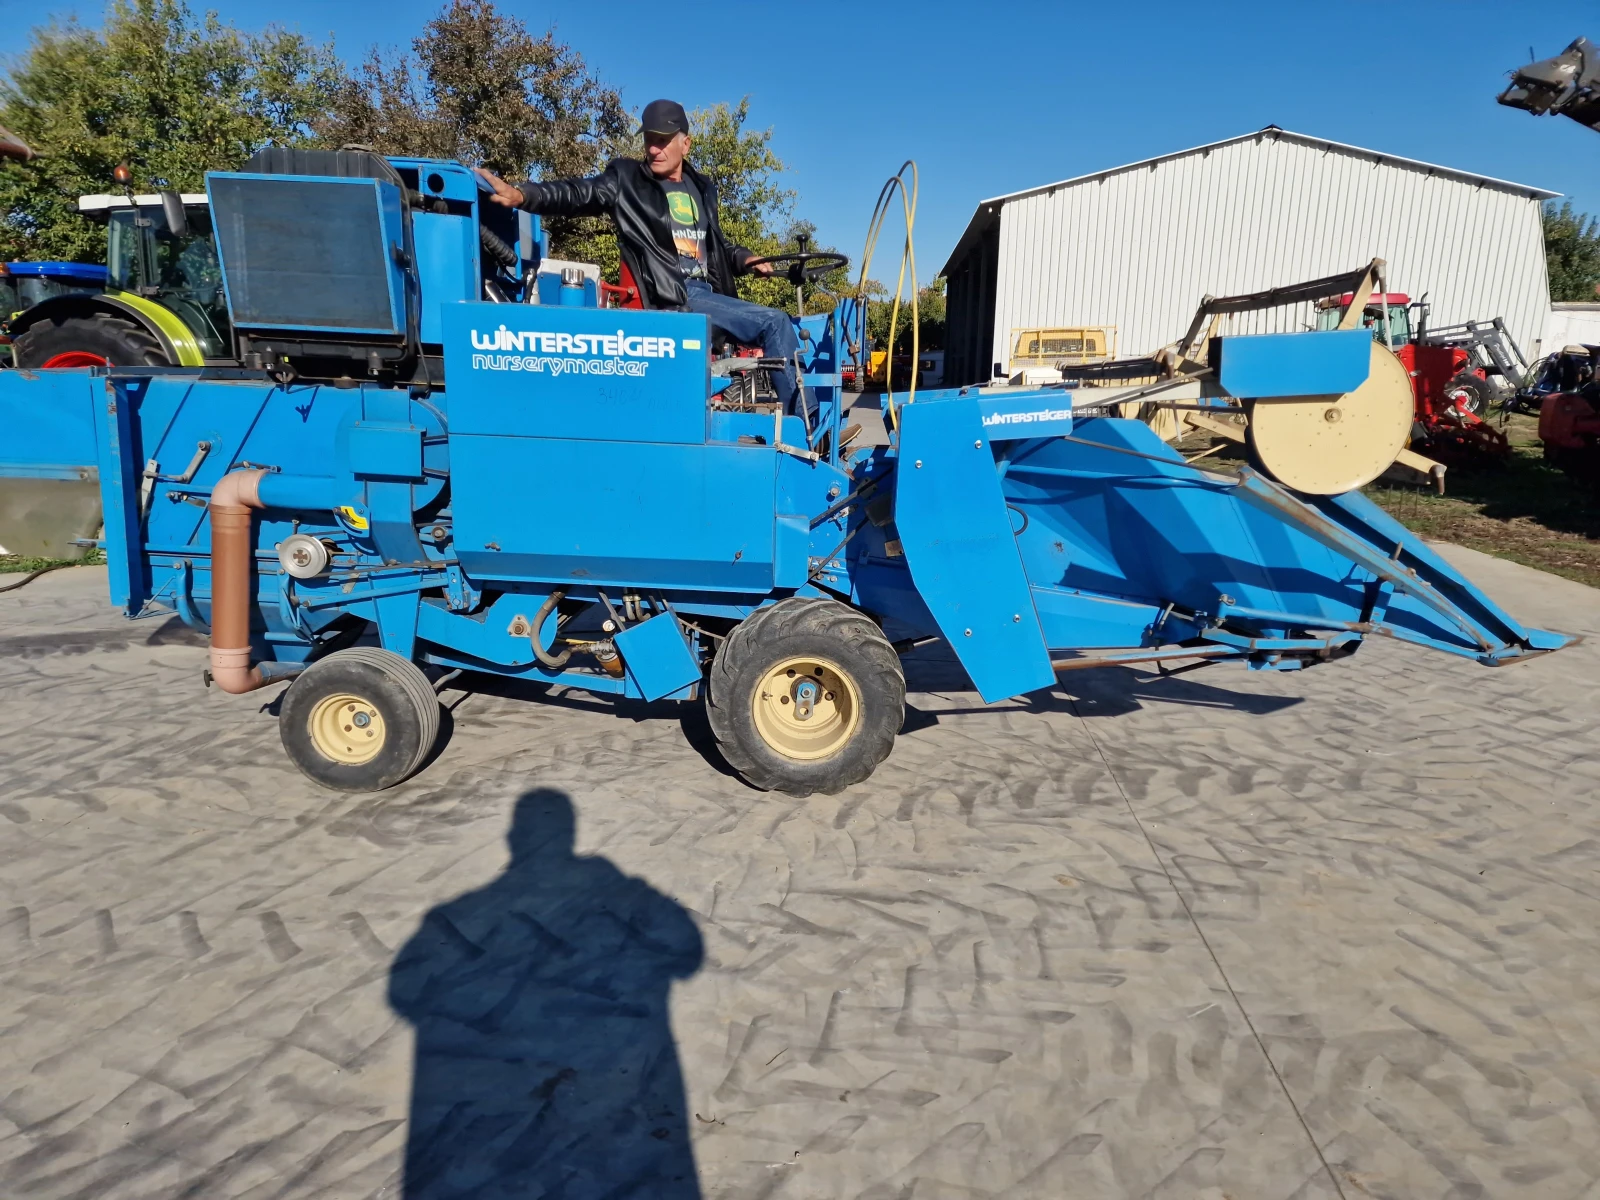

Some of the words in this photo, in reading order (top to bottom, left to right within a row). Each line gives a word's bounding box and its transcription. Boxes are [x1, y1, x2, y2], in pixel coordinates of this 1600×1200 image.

[471, 324, 675, 358] WINTERSTEIGER
[472, 354, 648, 377] nurserymaster
[982, 409, 1072, 427] WINTERSTEIGER
